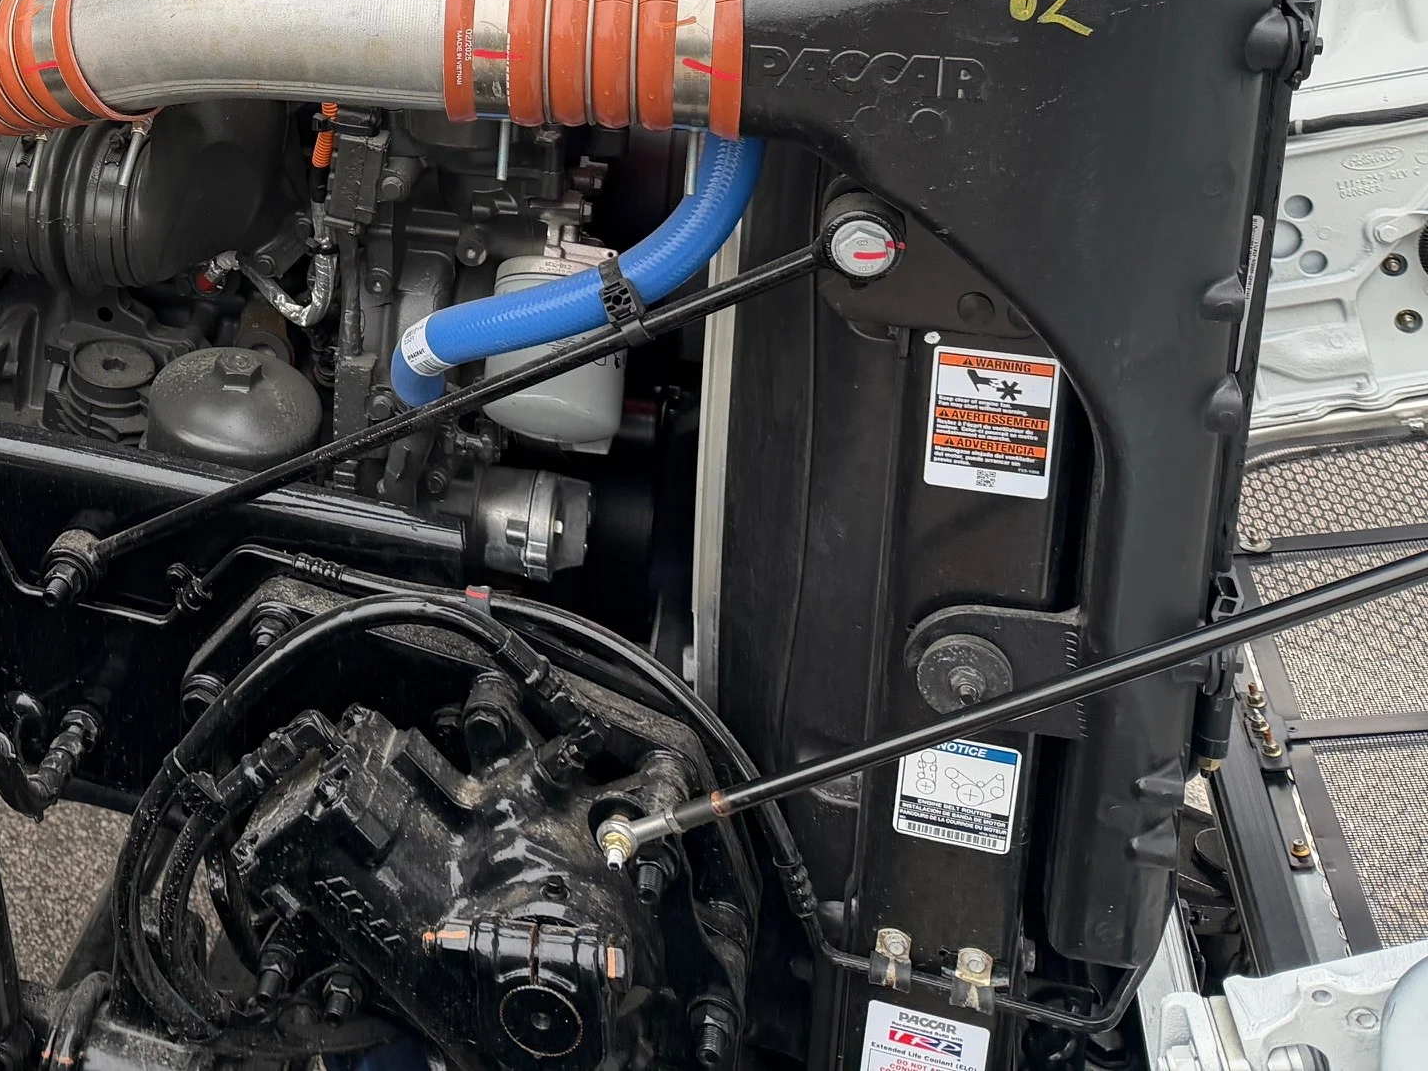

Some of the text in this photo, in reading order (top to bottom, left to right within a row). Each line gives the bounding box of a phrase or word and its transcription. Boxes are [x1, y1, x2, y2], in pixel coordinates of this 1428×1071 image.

[748, 44, 987, 101] PACCAR
[975, 359, 1032, 373] WARNING
[951, 410, 1045, 429] AVERTISSEMENT
[957, 438, 1035, 456] ADVERTENCIA
[935, 742, 987, 758] NOTICE
[917, 798, 942, 808] ENGINE
[961, 808, 992, 818] ROUTING
[951, 812, 973, 821] BANDA
[983, 819, 1006, 828] MOTOR
[892, 1021, 933, 1035] Recommended
[935, 1032, 950, 1040] Refill
[898, 1012, 957, 1035] PACCAR
[871, 1042, 906, 1055] Extended
[908, 1051, 922, 1059] Life
[924, 1056, 953, 1067] Coolant
[911, 1062, 927, 1071] NOT
